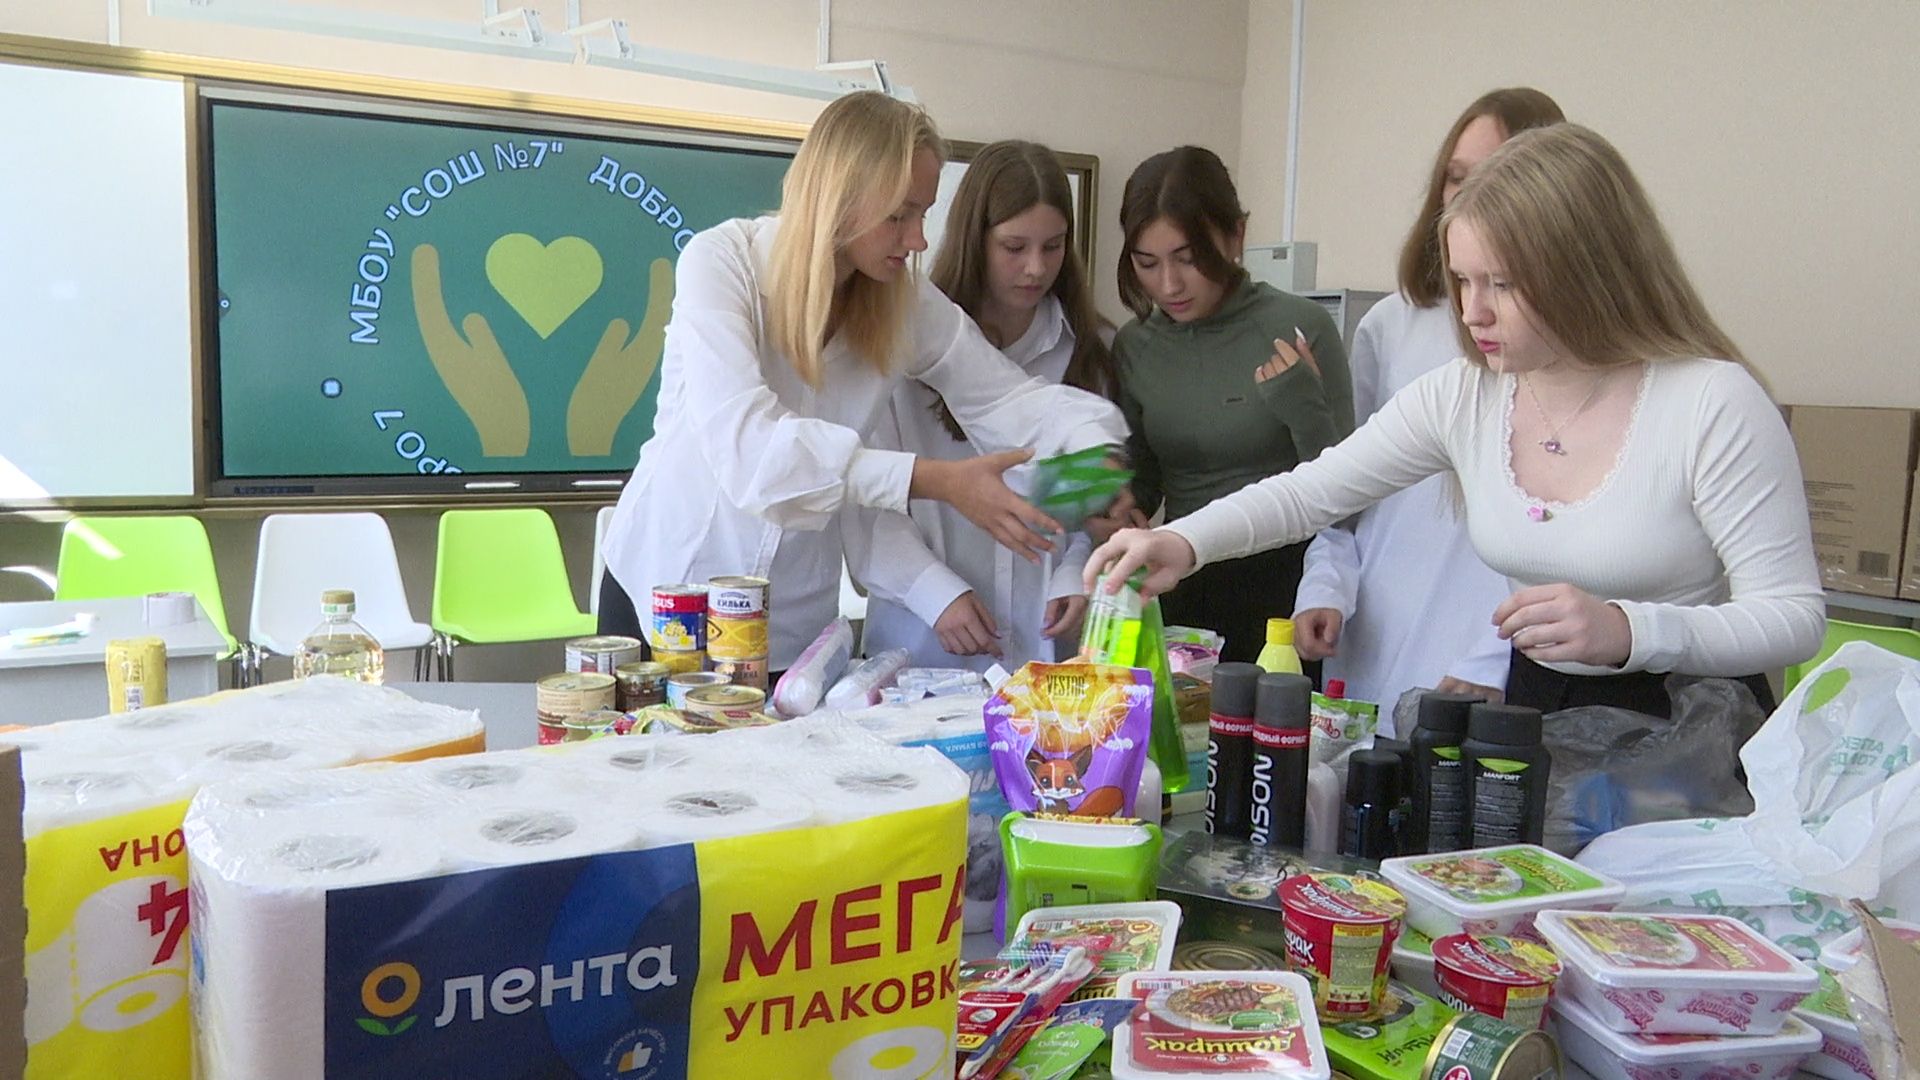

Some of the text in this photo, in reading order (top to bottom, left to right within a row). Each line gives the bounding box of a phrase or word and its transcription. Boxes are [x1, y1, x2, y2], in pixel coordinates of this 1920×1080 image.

[493, 140, 564, 172] №7"
[1482, 771, 1522, 781] MANFORT
[434, 944, 678, 1028] лента
